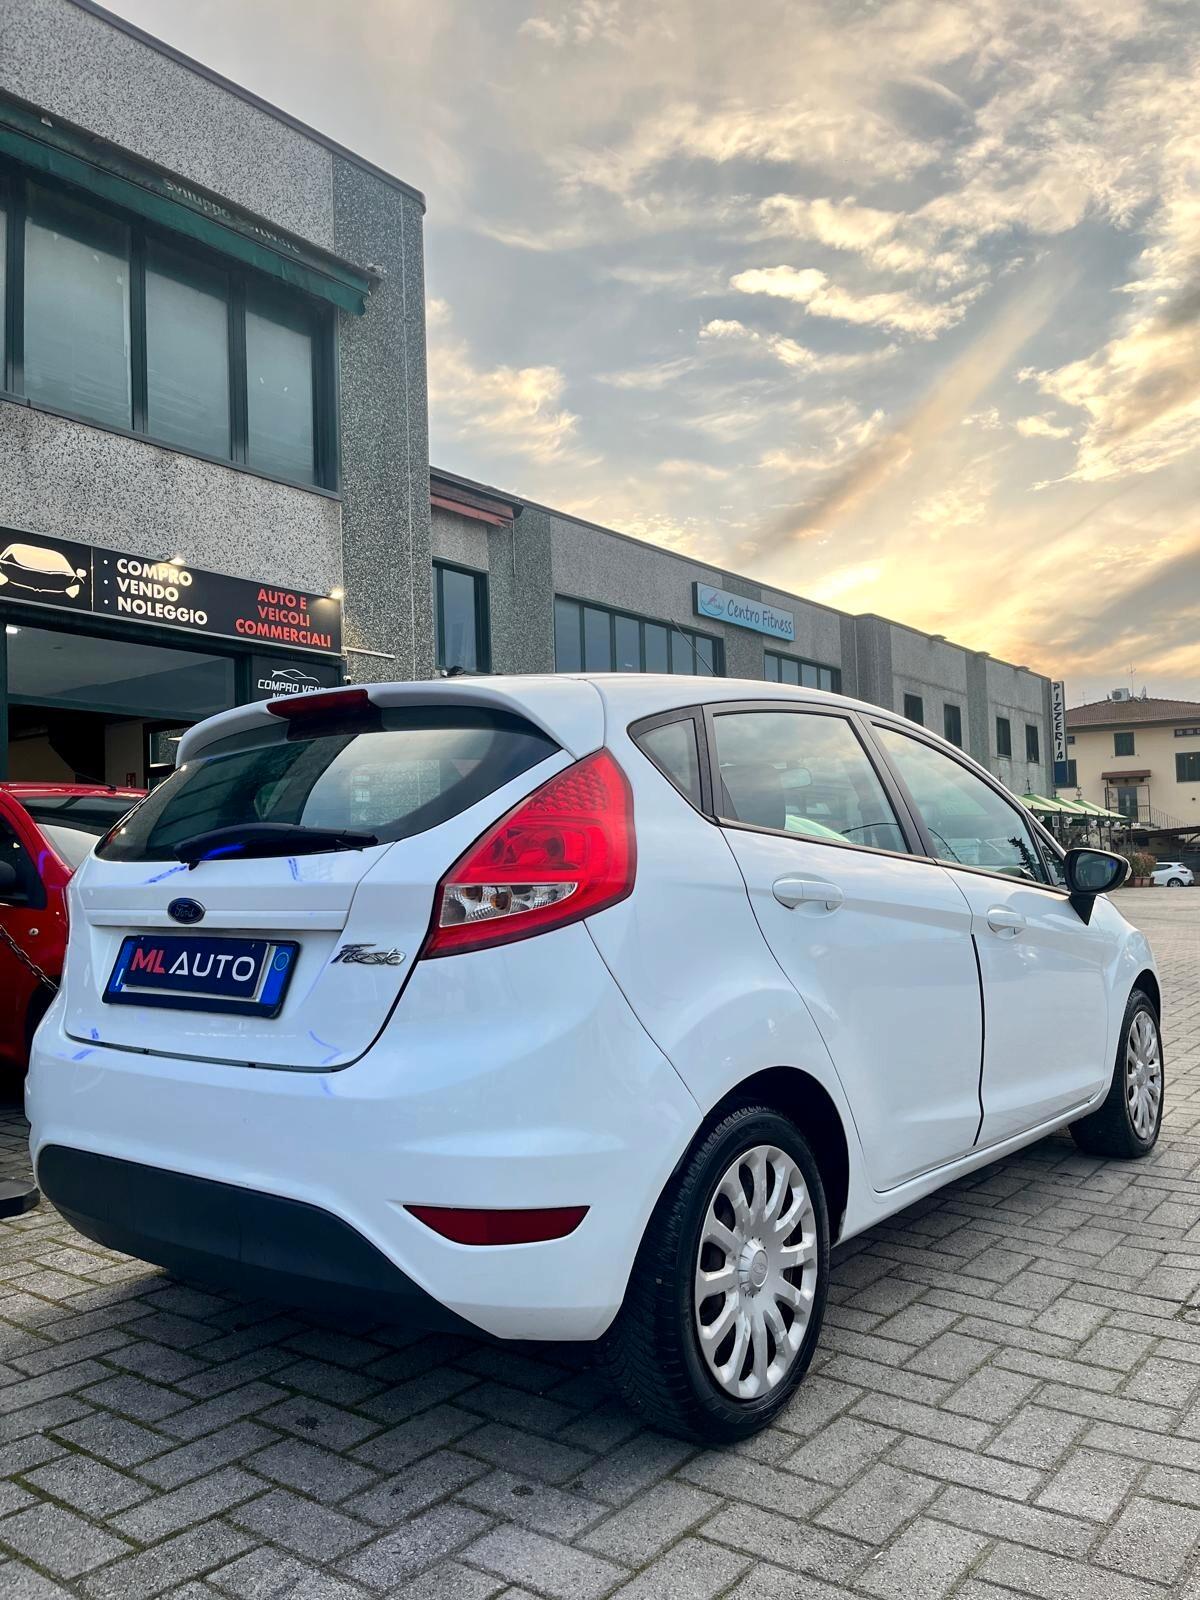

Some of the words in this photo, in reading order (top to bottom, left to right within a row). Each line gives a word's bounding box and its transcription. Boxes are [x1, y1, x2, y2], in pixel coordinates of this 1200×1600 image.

[117, 558, 193, 587] COMPRO
[116, 576, 179, 602] VENDO
[258, 588, 297, 608] AUTO
[300, 596, 307, 610] E
[117, 596, 208, 625] NOLEGGIO
[257, 605, 310, 627] VEICOLI
[727, 599, 760, 624] Centro
[762, 610, 793, 634] Fitness
[235, 618, 331, 648] COMMERCIALI
[257, 679, 299, 693] COMPRO
[1053, 683, 1063, 760] PIZZERIA
[174, 903, 195, 918] Ford
